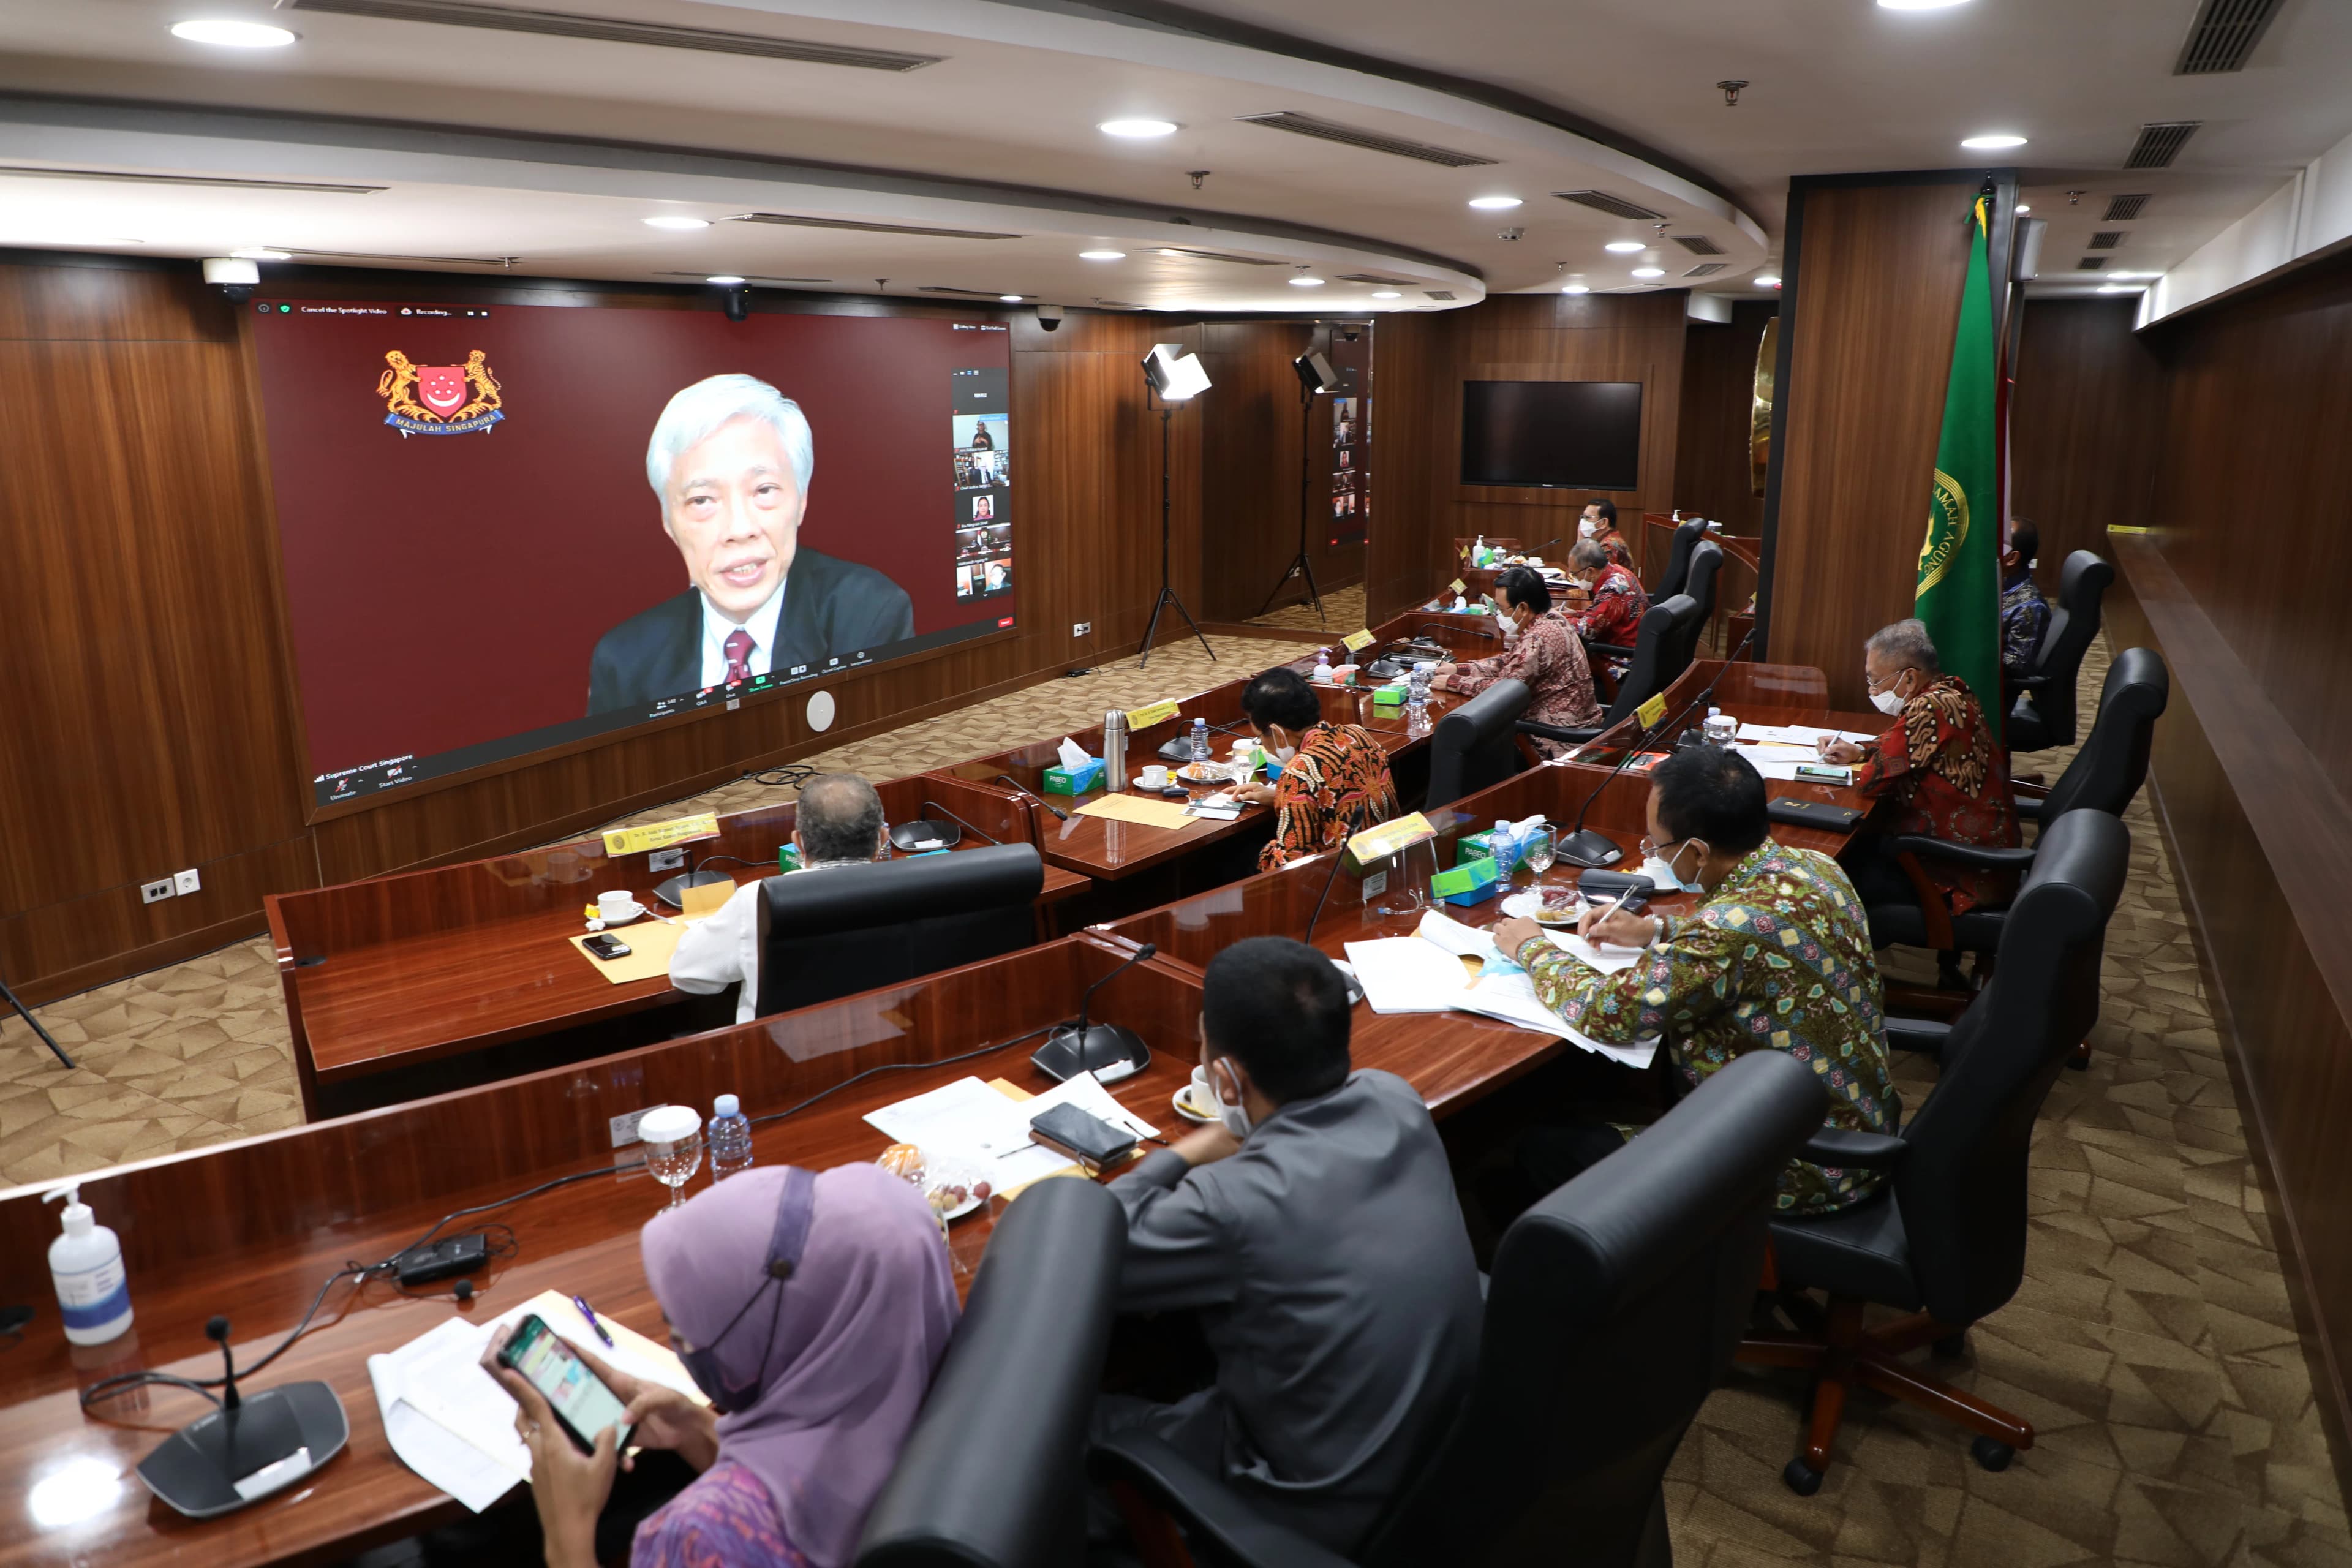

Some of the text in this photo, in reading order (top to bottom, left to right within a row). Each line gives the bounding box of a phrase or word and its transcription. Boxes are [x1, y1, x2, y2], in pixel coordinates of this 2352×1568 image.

[395, 415, 496, 432] MAJULAH SINGAPURA
[1924, 531, 1955, 576] AGUNG
[326, 755, 413, 780] Supreme Court Singapore
[330, 791, 356, 801] Unmute
[1464, 847, 1486, 859] PASEO
